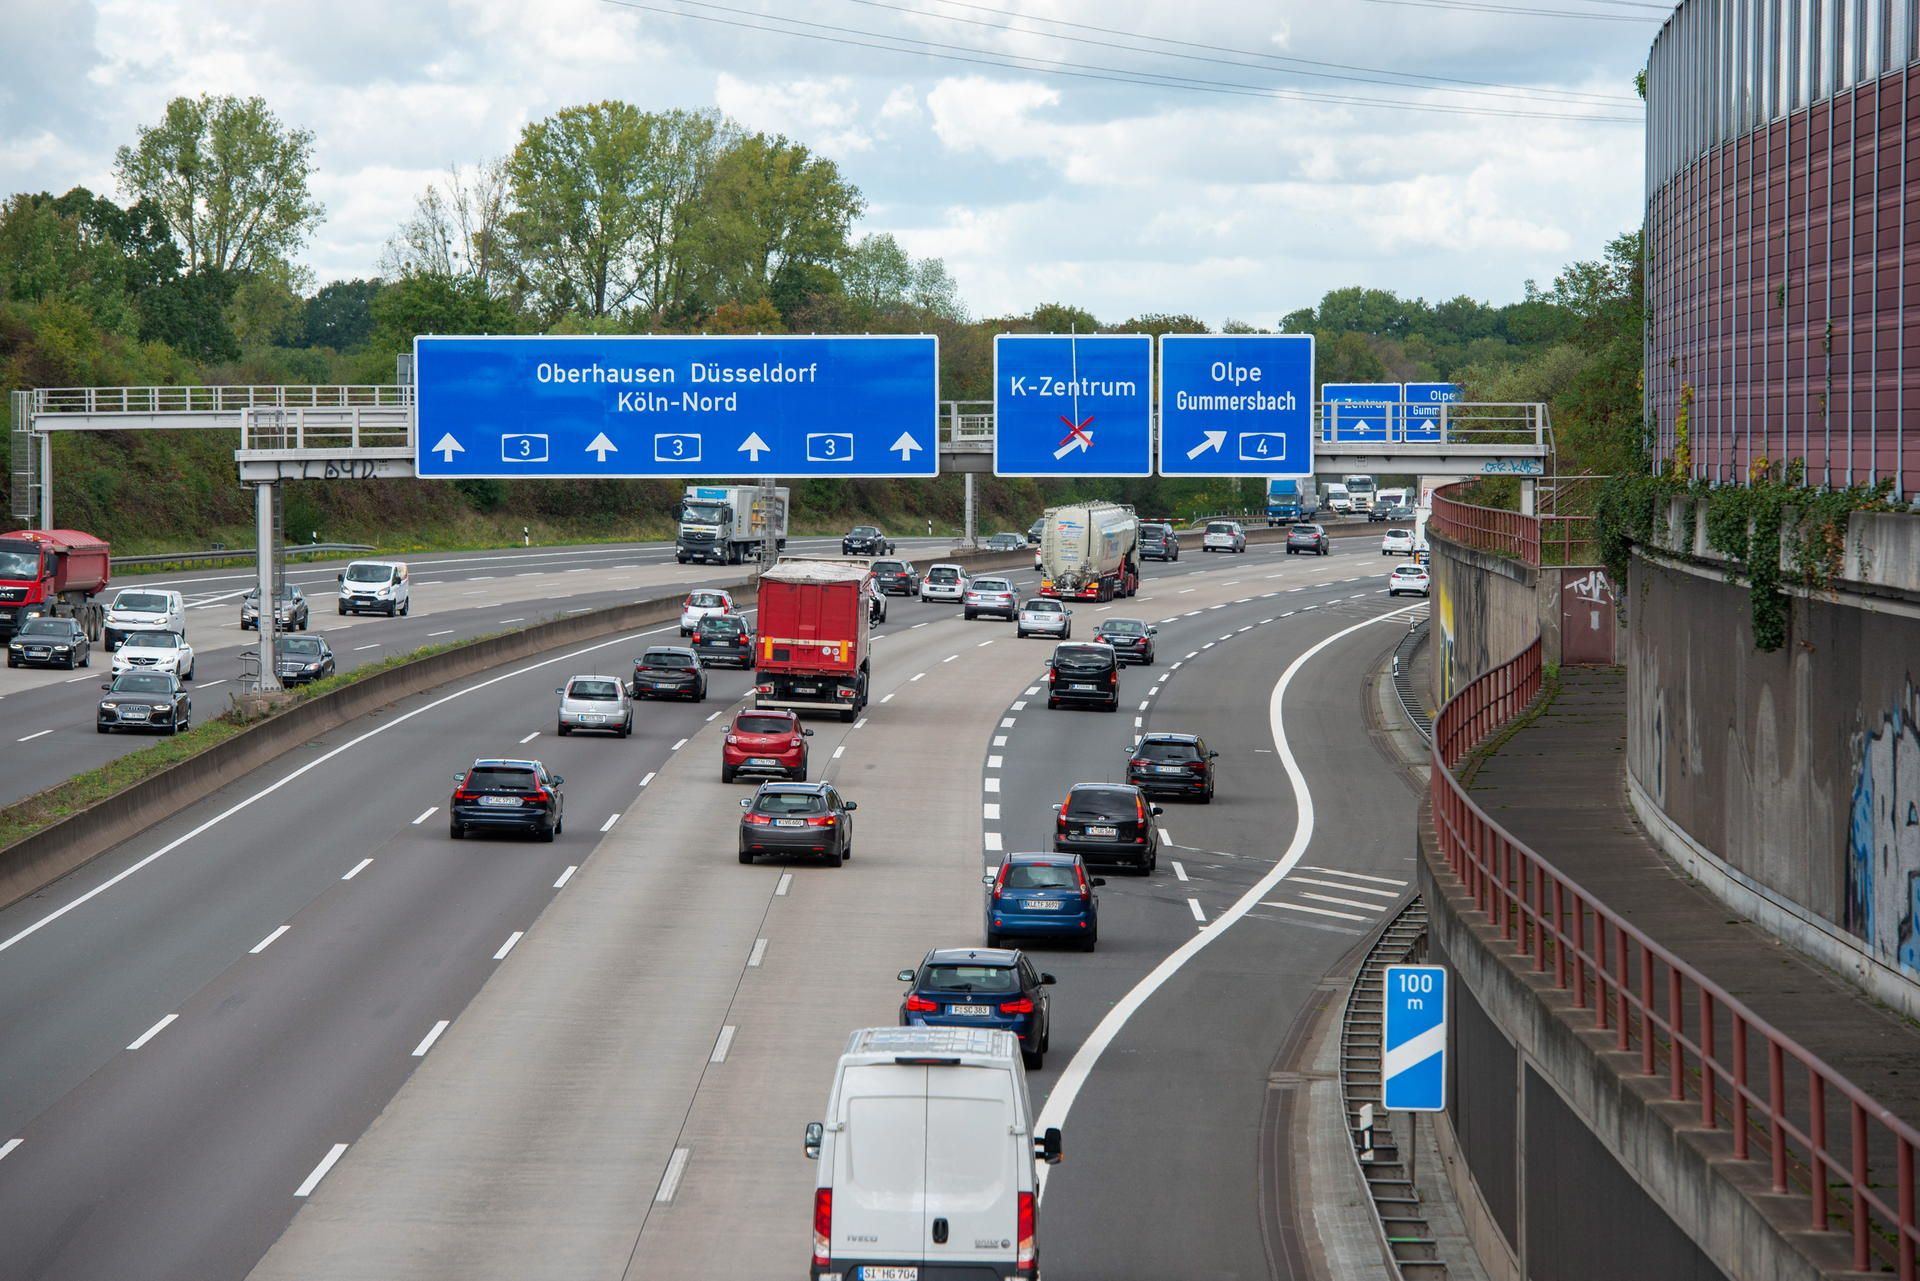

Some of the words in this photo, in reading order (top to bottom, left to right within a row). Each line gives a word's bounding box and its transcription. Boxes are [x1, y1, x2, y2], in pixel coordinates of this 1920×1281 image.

[537, 363, 675, 383] Oberhausen
[691, 362, 817, 383] Düsseldorf
[1211, 361, 1262, 383] Olpe
[1011, 376, 1136, 397] K-Zentrum
[618, 391, 737, 412] Köln-Nord
[1176, 390, 1296, 411] Gummersbach
[1430, 390, 1456, 404] Olpe
[520, 440, 530, 456] 3
[673, 440, 683, 456] 3
[825, 439, 836, 456] 3
[1256, 438, 1268, 455] 4
[1399, 974, 1432, 993] 100
[1407, 998, 1423, 1010] m
[864, 1268, 876, 1279] SI
[882, 1269, 896, 1279] HG
[897, 1269, 916, 1279] 704
